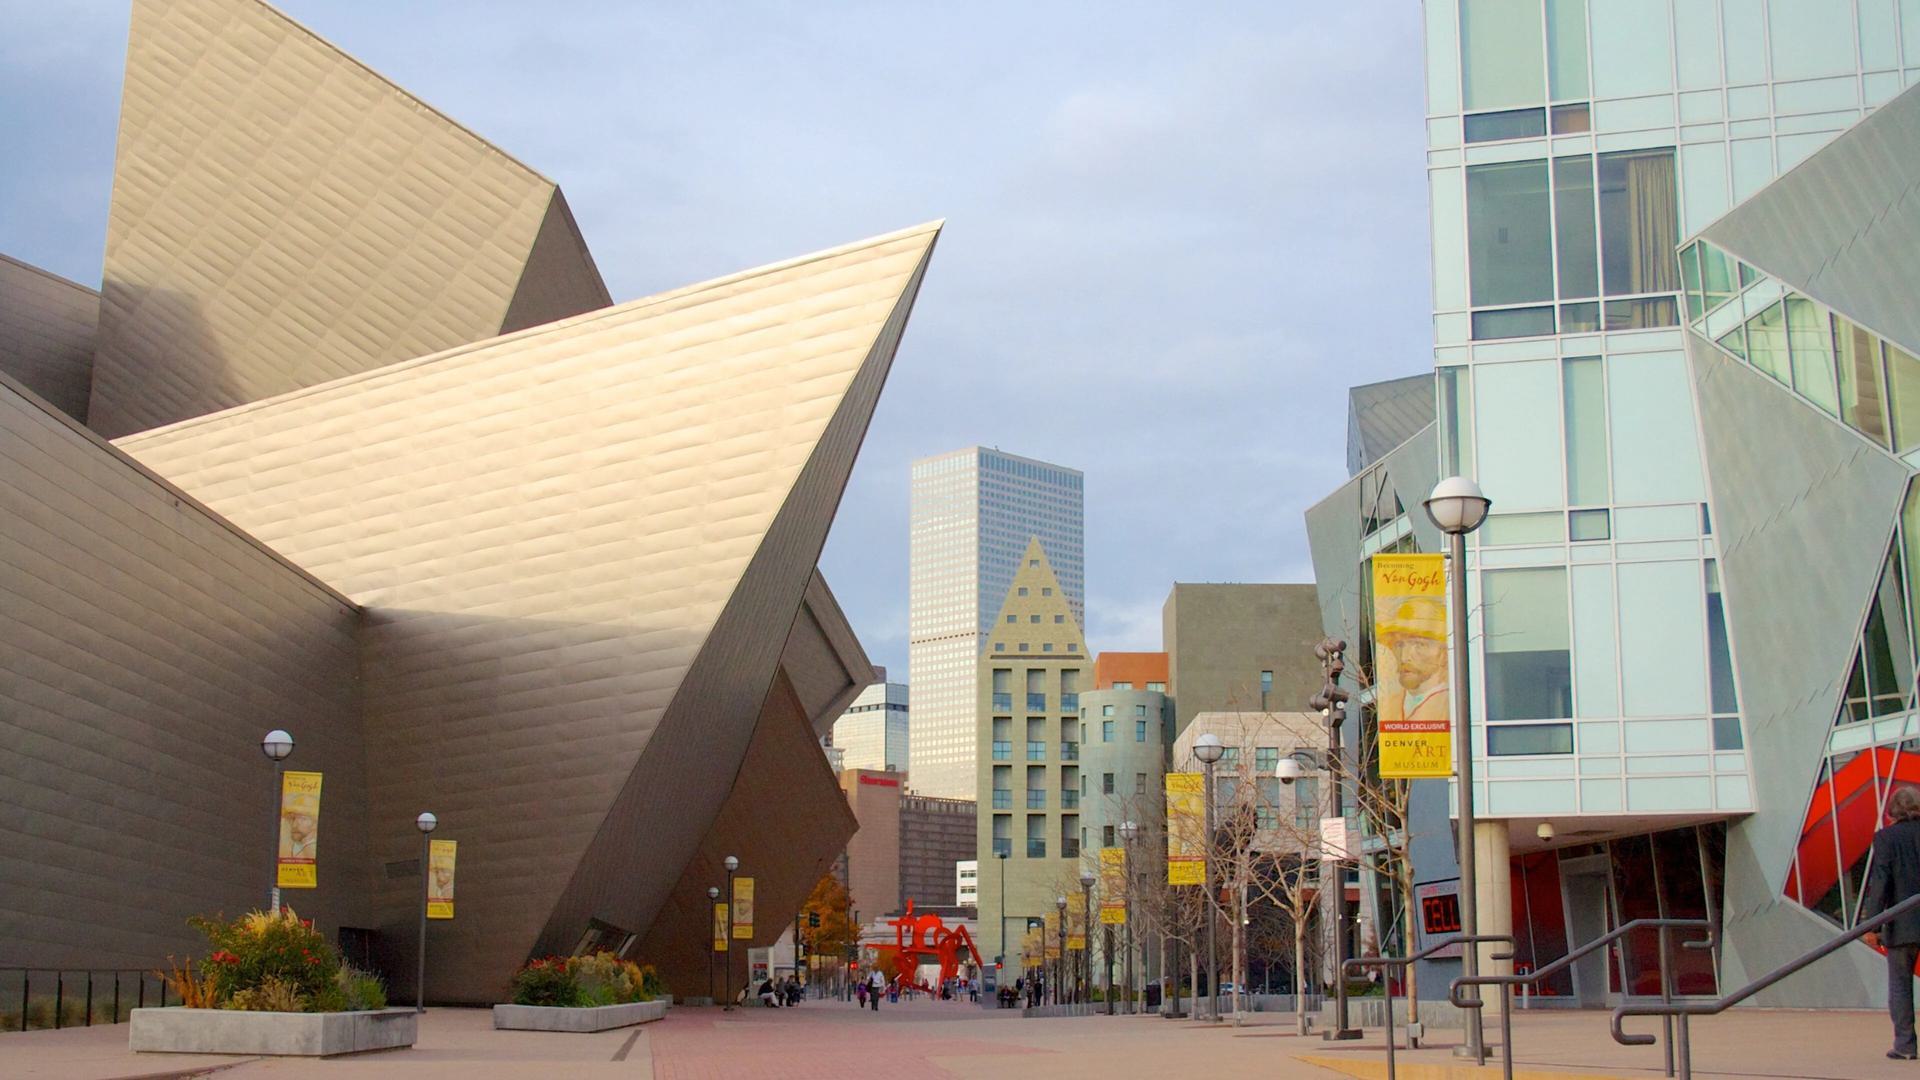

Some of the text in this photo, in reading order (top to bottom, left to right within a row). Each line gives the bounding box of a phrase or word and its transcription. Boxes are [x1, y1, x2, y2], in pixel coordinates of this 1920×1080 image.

[1407, 571, 1440, 592] Gogh
[1384, 723, 1446, 731] WORLD EXCLUSIVE
[1413, 745, 1447, 758] ART
